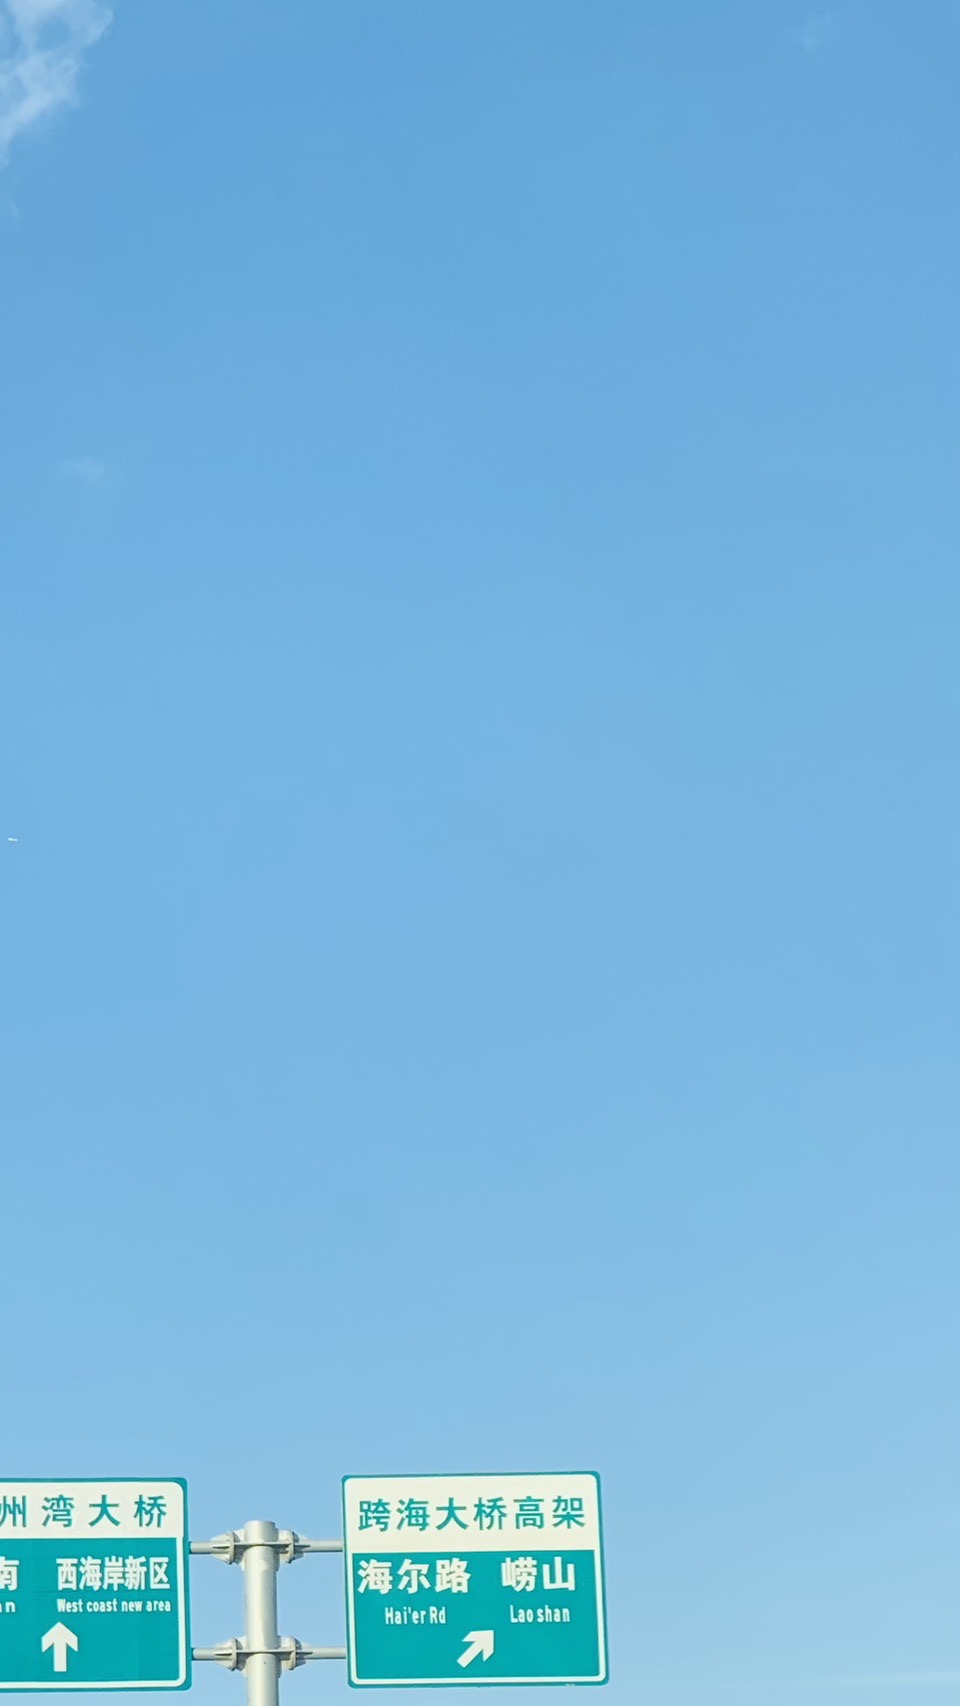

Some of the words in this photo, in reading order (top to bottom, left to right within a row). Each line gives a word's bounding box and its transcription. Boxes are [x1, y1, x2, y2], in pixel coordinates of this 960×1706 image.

[358, 1495, 586, 1532] 跨海大桥高架
[55, 1555, 171, 1591] 西海岸新区
[357, 1557, 471, 1595] 海尔路
[500, 1556, 576, 1592] 崂山
[56, 1598, 83, 1613] West
[86, 1599, 118, 1613] coast
[121, 1600, 143, 1612] new
[145, 1600, 171, 1612] area
[384, 1606, 427, 1625] Hai'er
[429, 1606, 447, 1624] Rd
